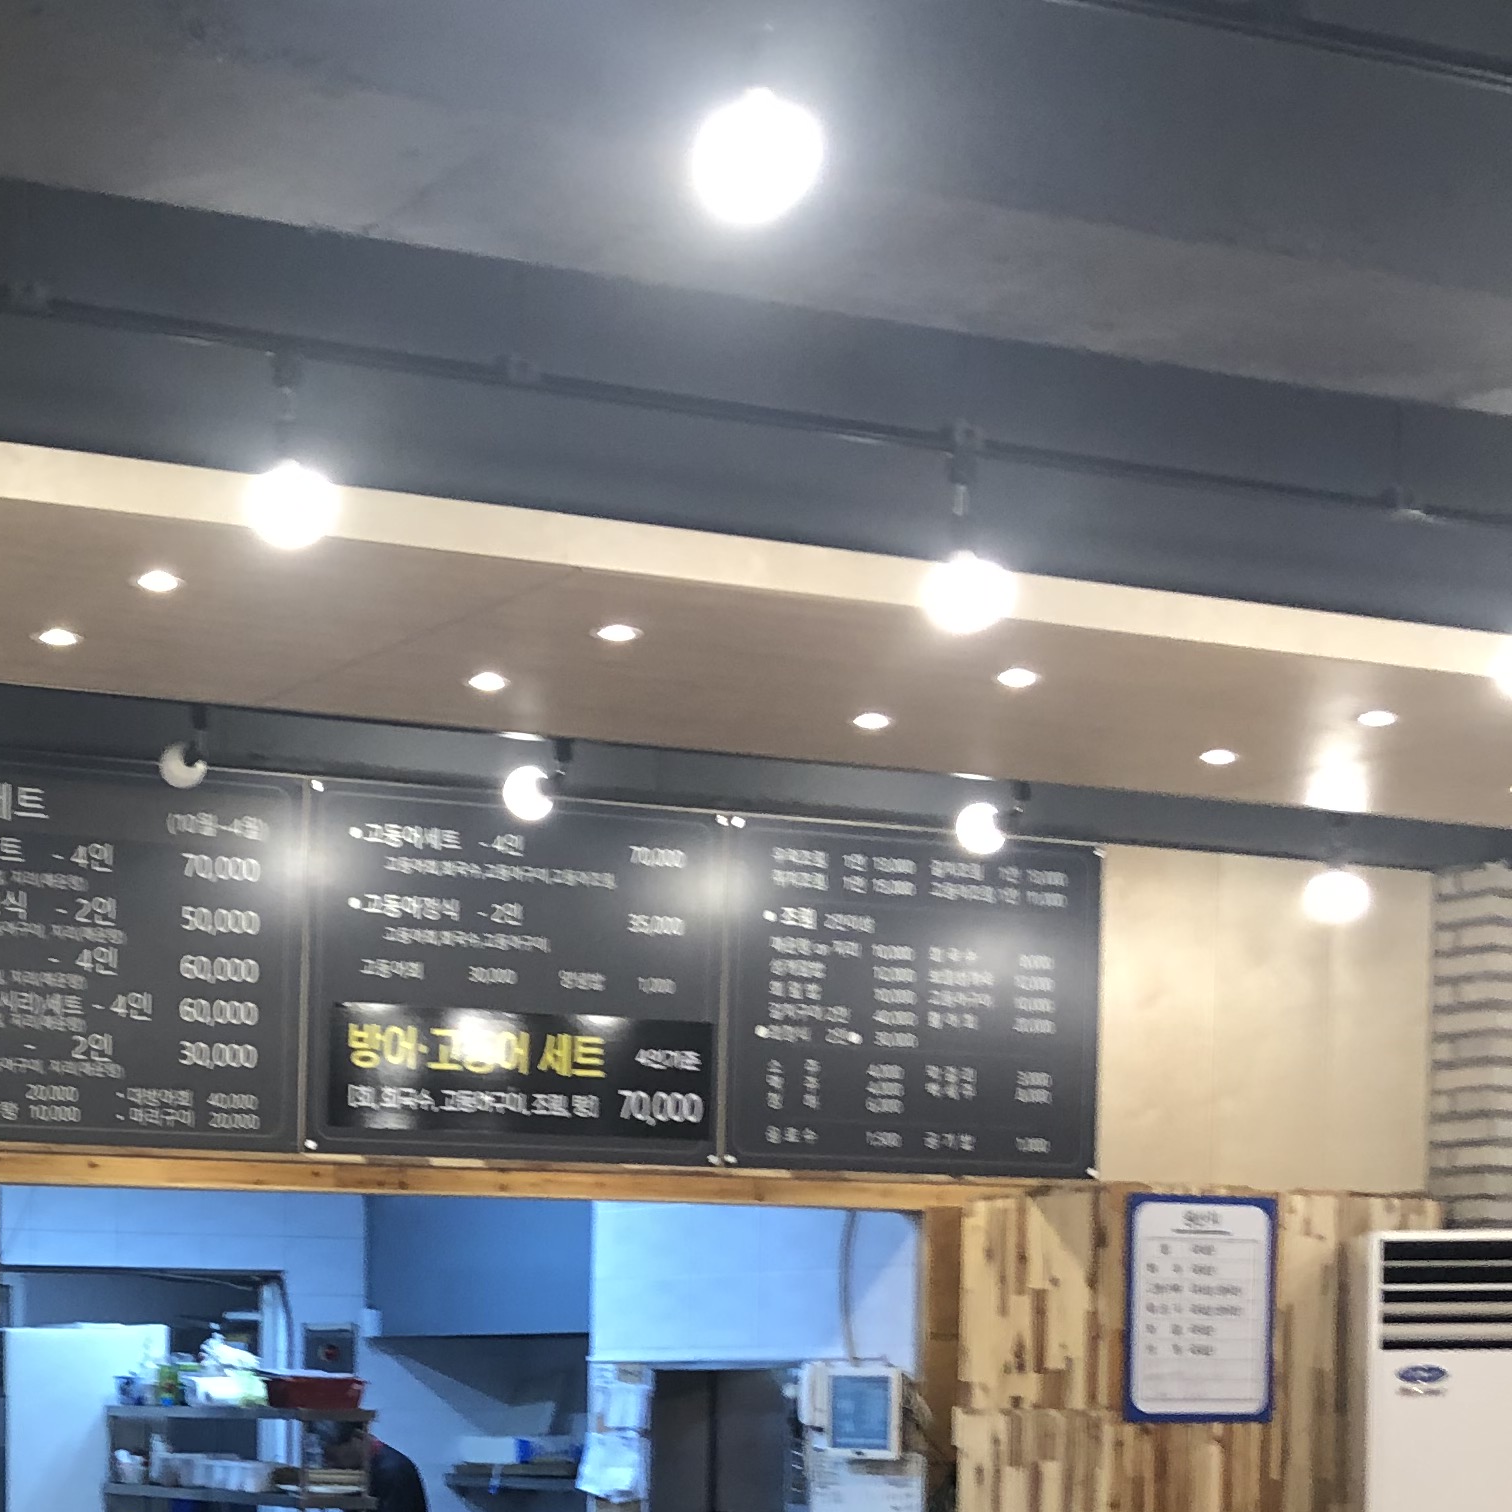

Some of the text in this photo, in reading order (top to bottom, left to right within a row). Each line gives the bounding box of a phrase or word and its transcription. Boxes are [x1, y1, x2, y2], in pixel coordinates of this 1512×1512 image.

[181, 853, 261, 883] 70,000
[181, 906, 261, 936] 50,000
[180, 954, 260, 984] 60,000
[179, 998, 259, 1026] 60,000
[178, 1040, 259, 1069] 30,000
[538, 1033, 606, 1078] 세트
[618, 1089, 704, 1126] 70,000
